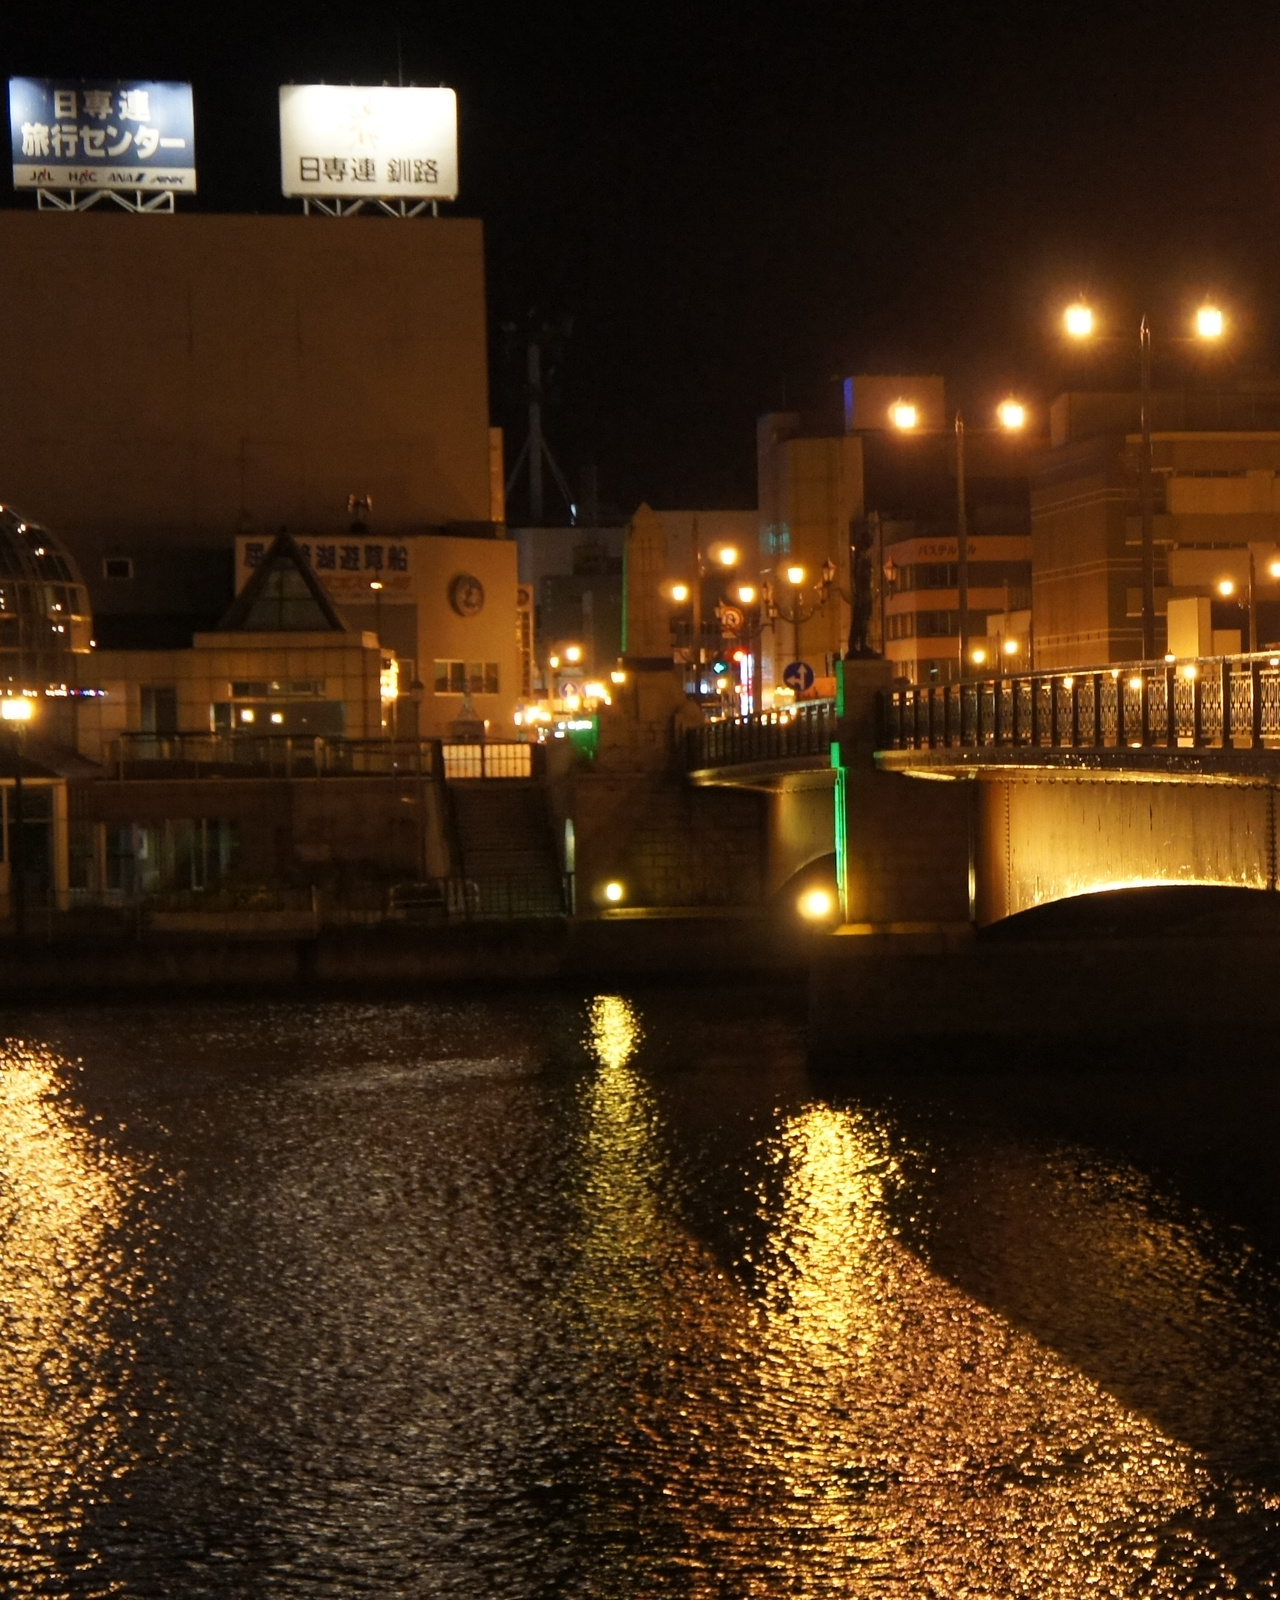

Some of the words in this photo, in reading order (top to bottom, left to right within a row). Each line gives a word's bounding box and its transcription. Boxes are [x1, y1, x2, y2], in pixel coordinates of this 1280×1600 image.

[21, 122, 186, 160] 旅行センター
[29, 168, 54, 184] JAL
[68, 169, 98, 184] HAC
[108, 172, 133, 182] ANA
[387, 158, 438, 184] 釧路
[918, 544, 977, 556] パステルル
